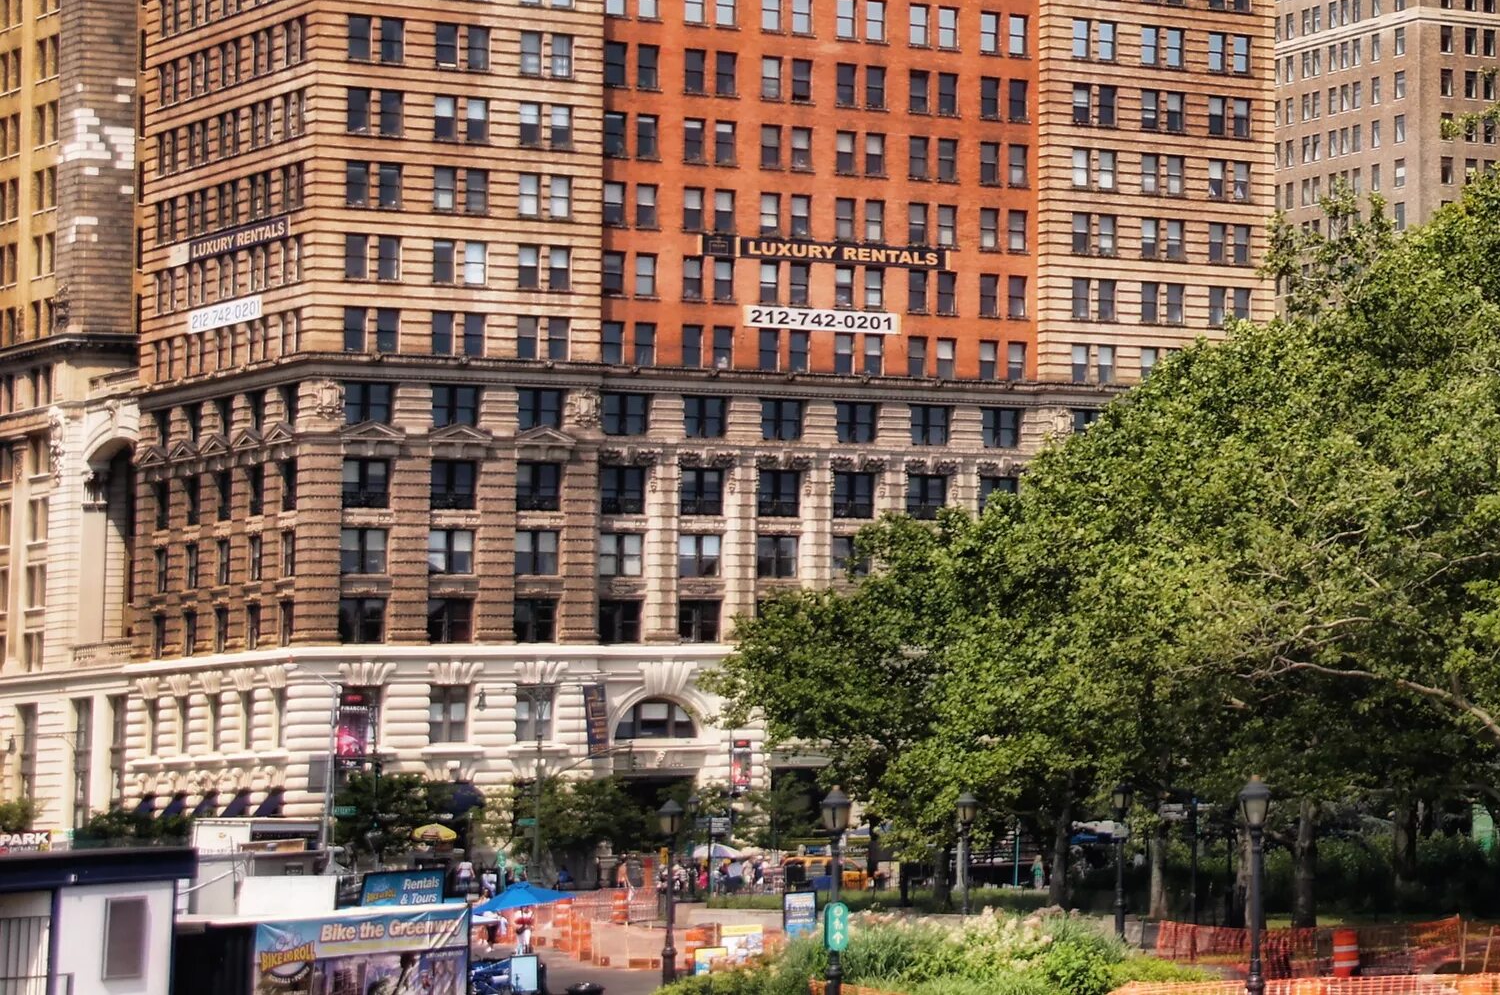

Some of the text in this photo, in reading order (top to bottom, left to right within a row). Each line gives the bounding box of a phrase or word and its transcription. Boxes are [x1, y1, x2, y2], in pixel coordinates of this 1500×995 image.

[192, 221, 285, 259] LUXURY RENTALS
[749, 241, 939, 266] LUXURY RENTALS
[751, 309, 893, 331] 212-742-0201
[0, 832, 49, 846] PARK
[403, 876, 440, 890] Rentals
[400, 893, 437, 905] & Tours
[320, 918, 461, 943] Bike the Greenway
[261, 951, 284, 972] BIKE
[293, 941, 316, 962] ROLL
